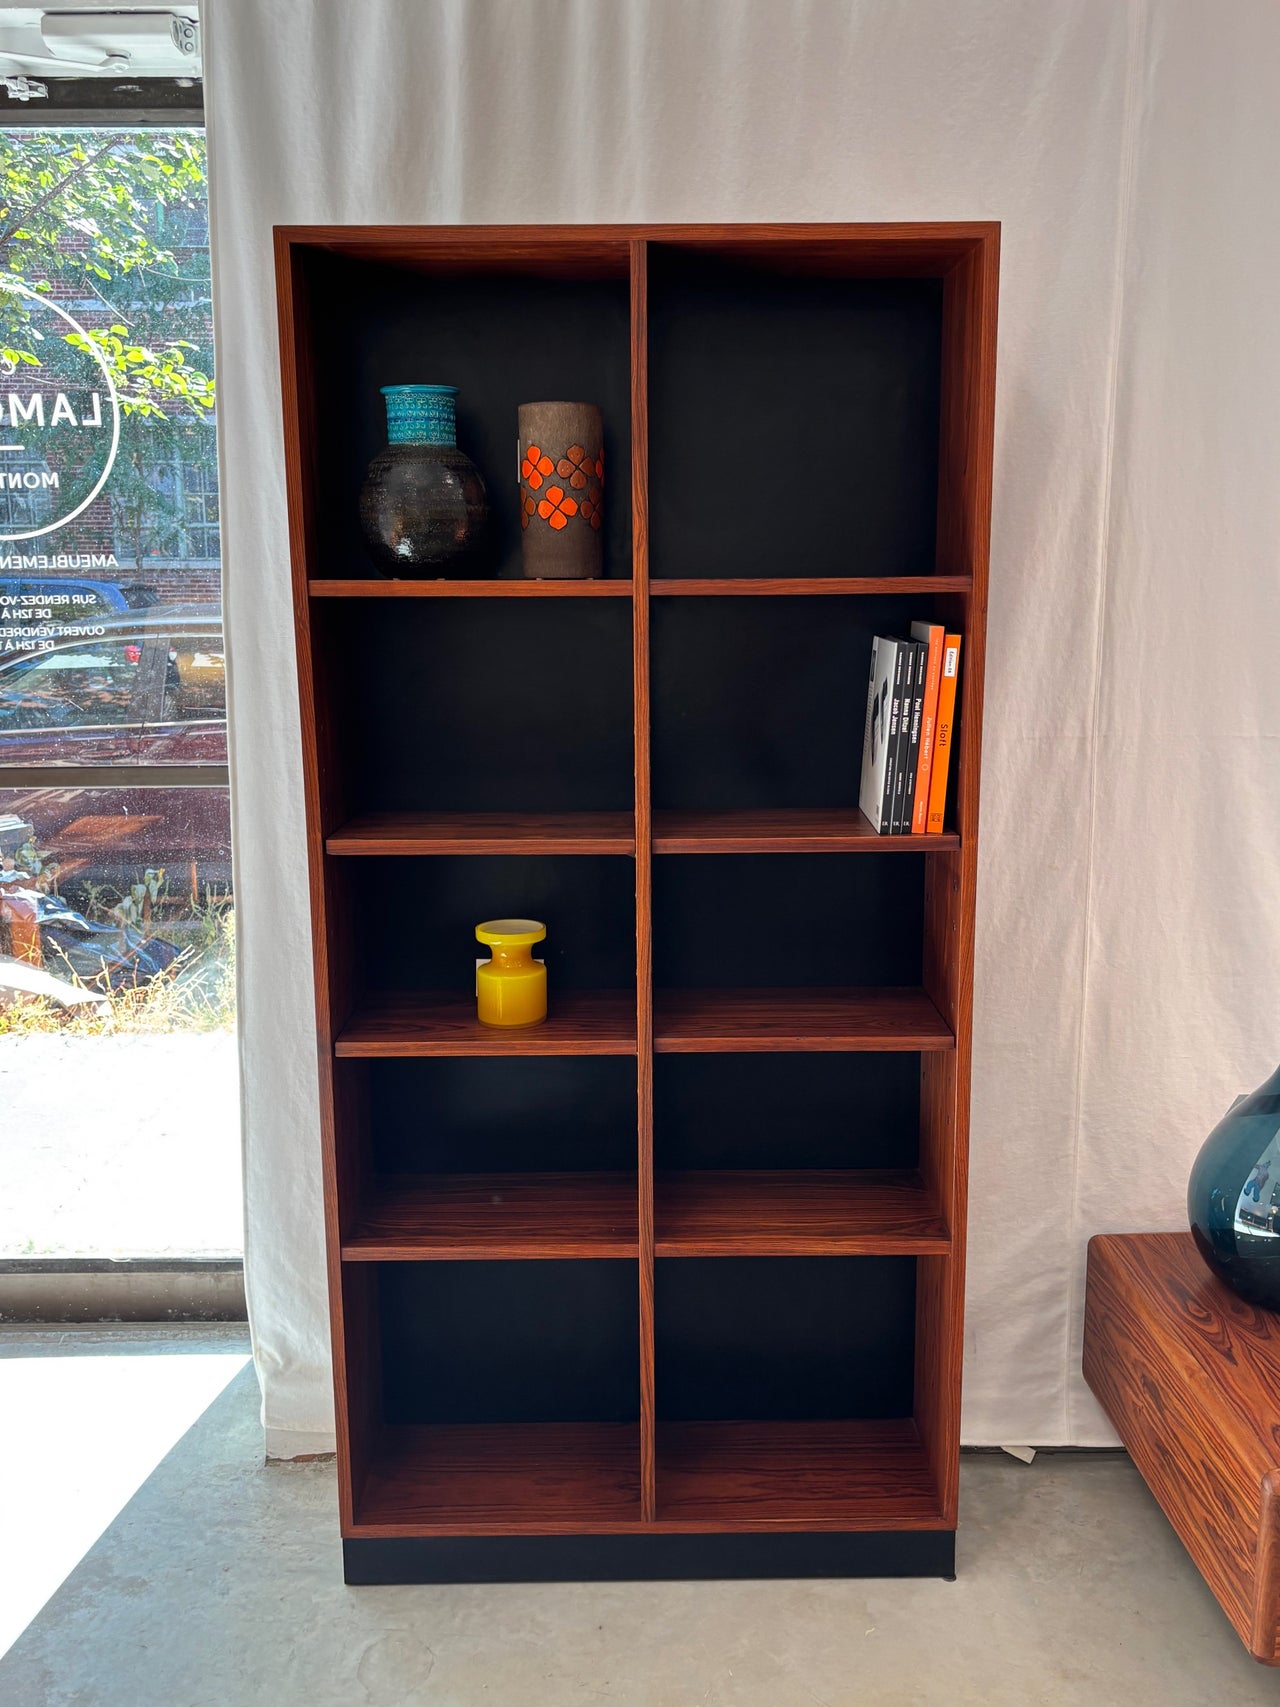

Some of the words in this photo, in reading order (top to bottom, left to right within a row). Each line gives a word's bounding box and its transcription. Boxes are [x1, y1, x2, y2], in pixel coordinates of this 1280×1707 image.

[892, 698, 900, 715] Jacob
[890, 715, 898, 735] Jensen
[911, 711, 921, 744] Henningsen
[939, 724, 948, 747] Sloft
